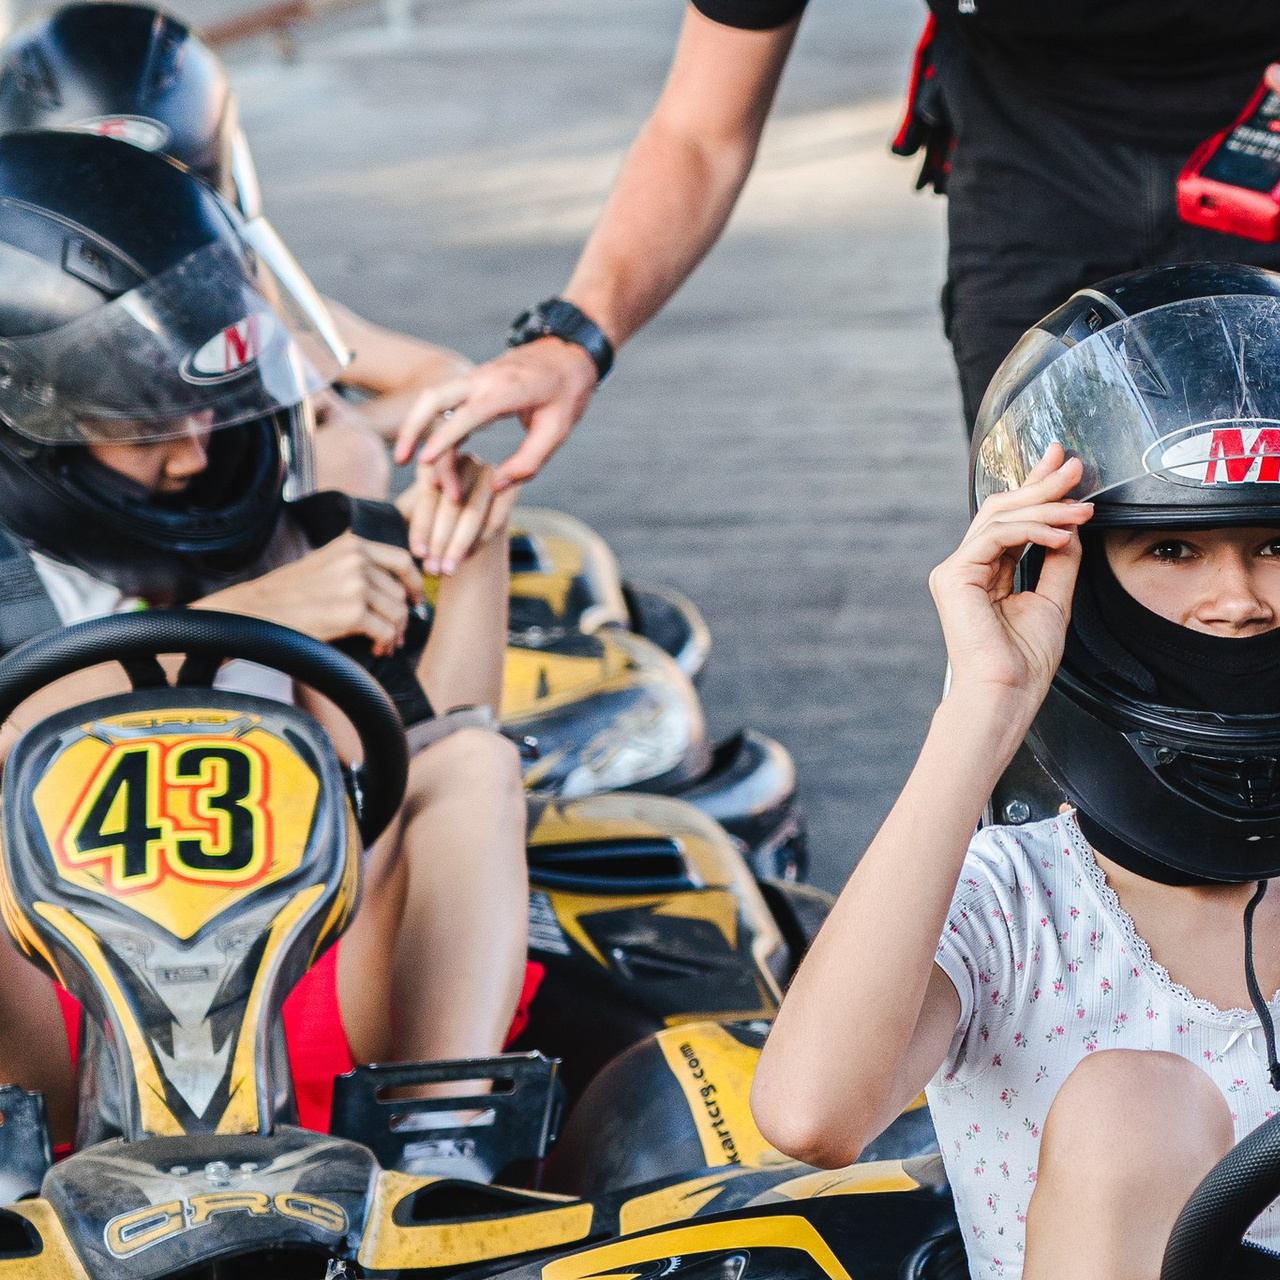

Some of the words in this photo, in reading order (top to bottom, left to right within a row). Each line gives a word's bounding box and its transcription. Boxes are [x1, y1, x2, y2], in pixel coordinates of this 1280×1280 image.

[57, 737, 273, 896] 43
[680, 1042, 741, 1166] kartcrg.com
[104, 1191, 350, 1260] CRG
